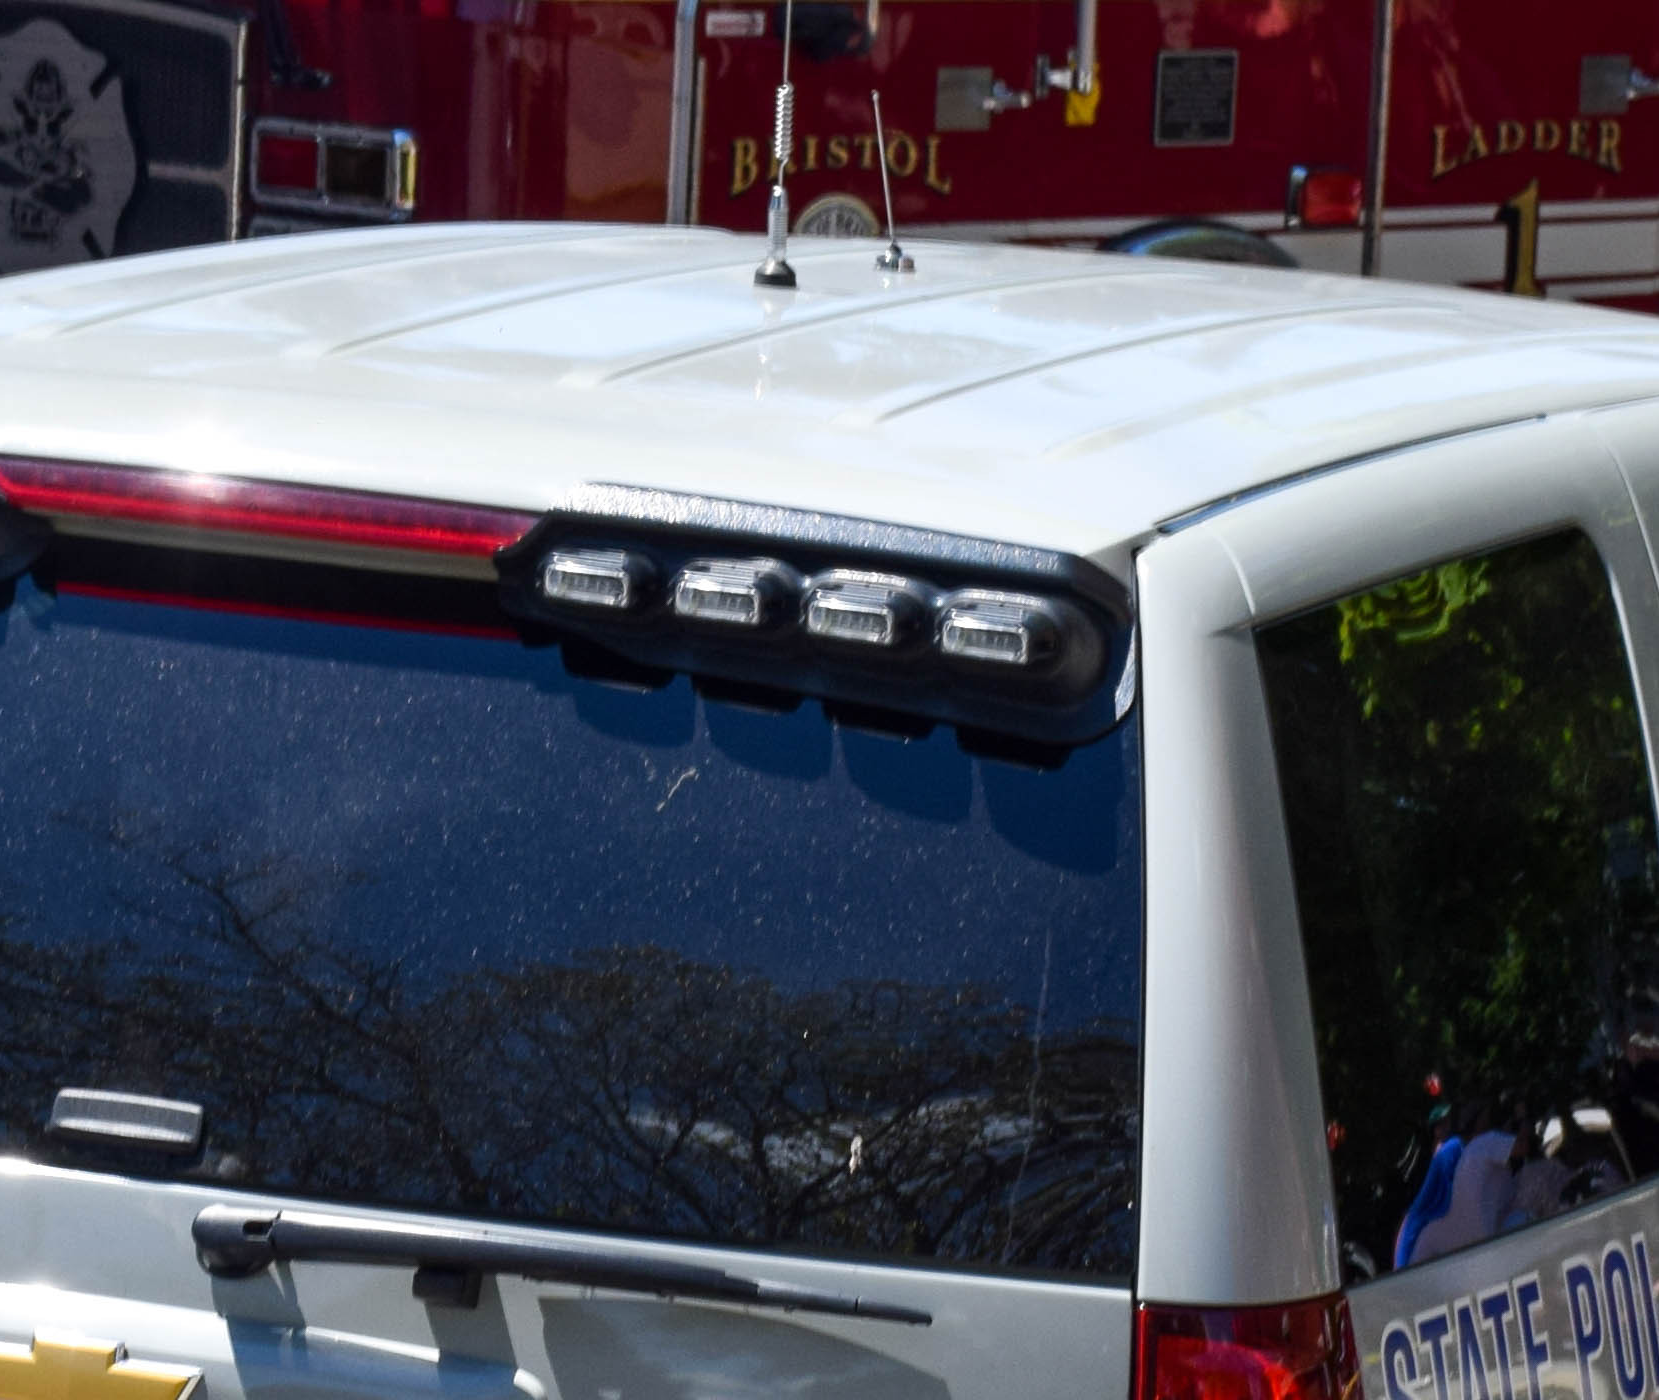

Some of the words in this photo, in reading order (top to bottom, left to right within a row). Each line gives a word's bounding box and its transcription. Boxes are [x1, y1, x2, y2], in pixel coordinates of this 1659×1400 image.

[731, 131, 953, 196] BRISTOL
[1431, 118, 1623, 180] LADDER
[1498, 176, 1545, 298] 1
